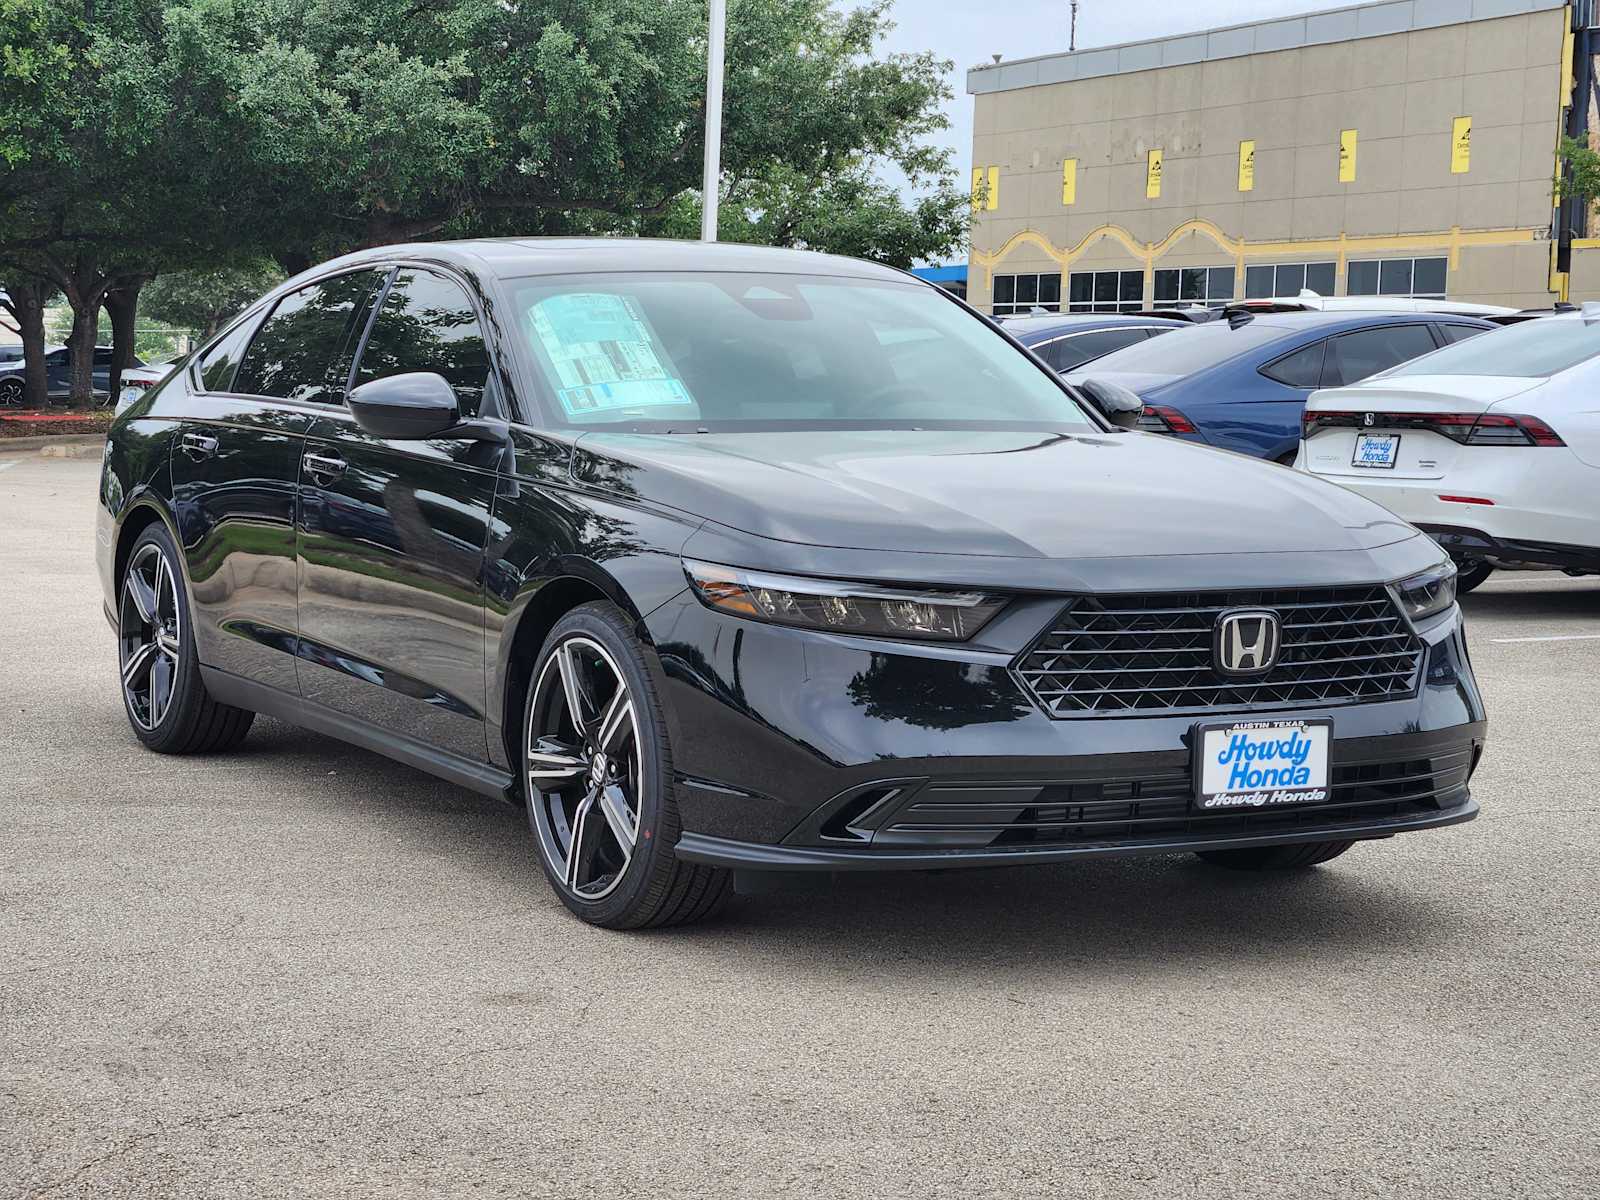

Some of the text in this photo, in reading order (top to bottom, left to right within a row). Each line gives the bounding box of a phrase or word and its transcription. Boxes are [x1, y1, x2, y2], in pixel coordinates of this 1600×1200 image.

[1361, 438, 1392, 453] Howdy
[1362, 450, 1390, 462] Honda
[1233, 720, 1305, 730] AUSTIN TEXAS
[1218, 731, 1312, 766] Howdy
[1227, 762, 1311, 790] Honda
[1204, 788, 1327, 807] Howdy Honda
